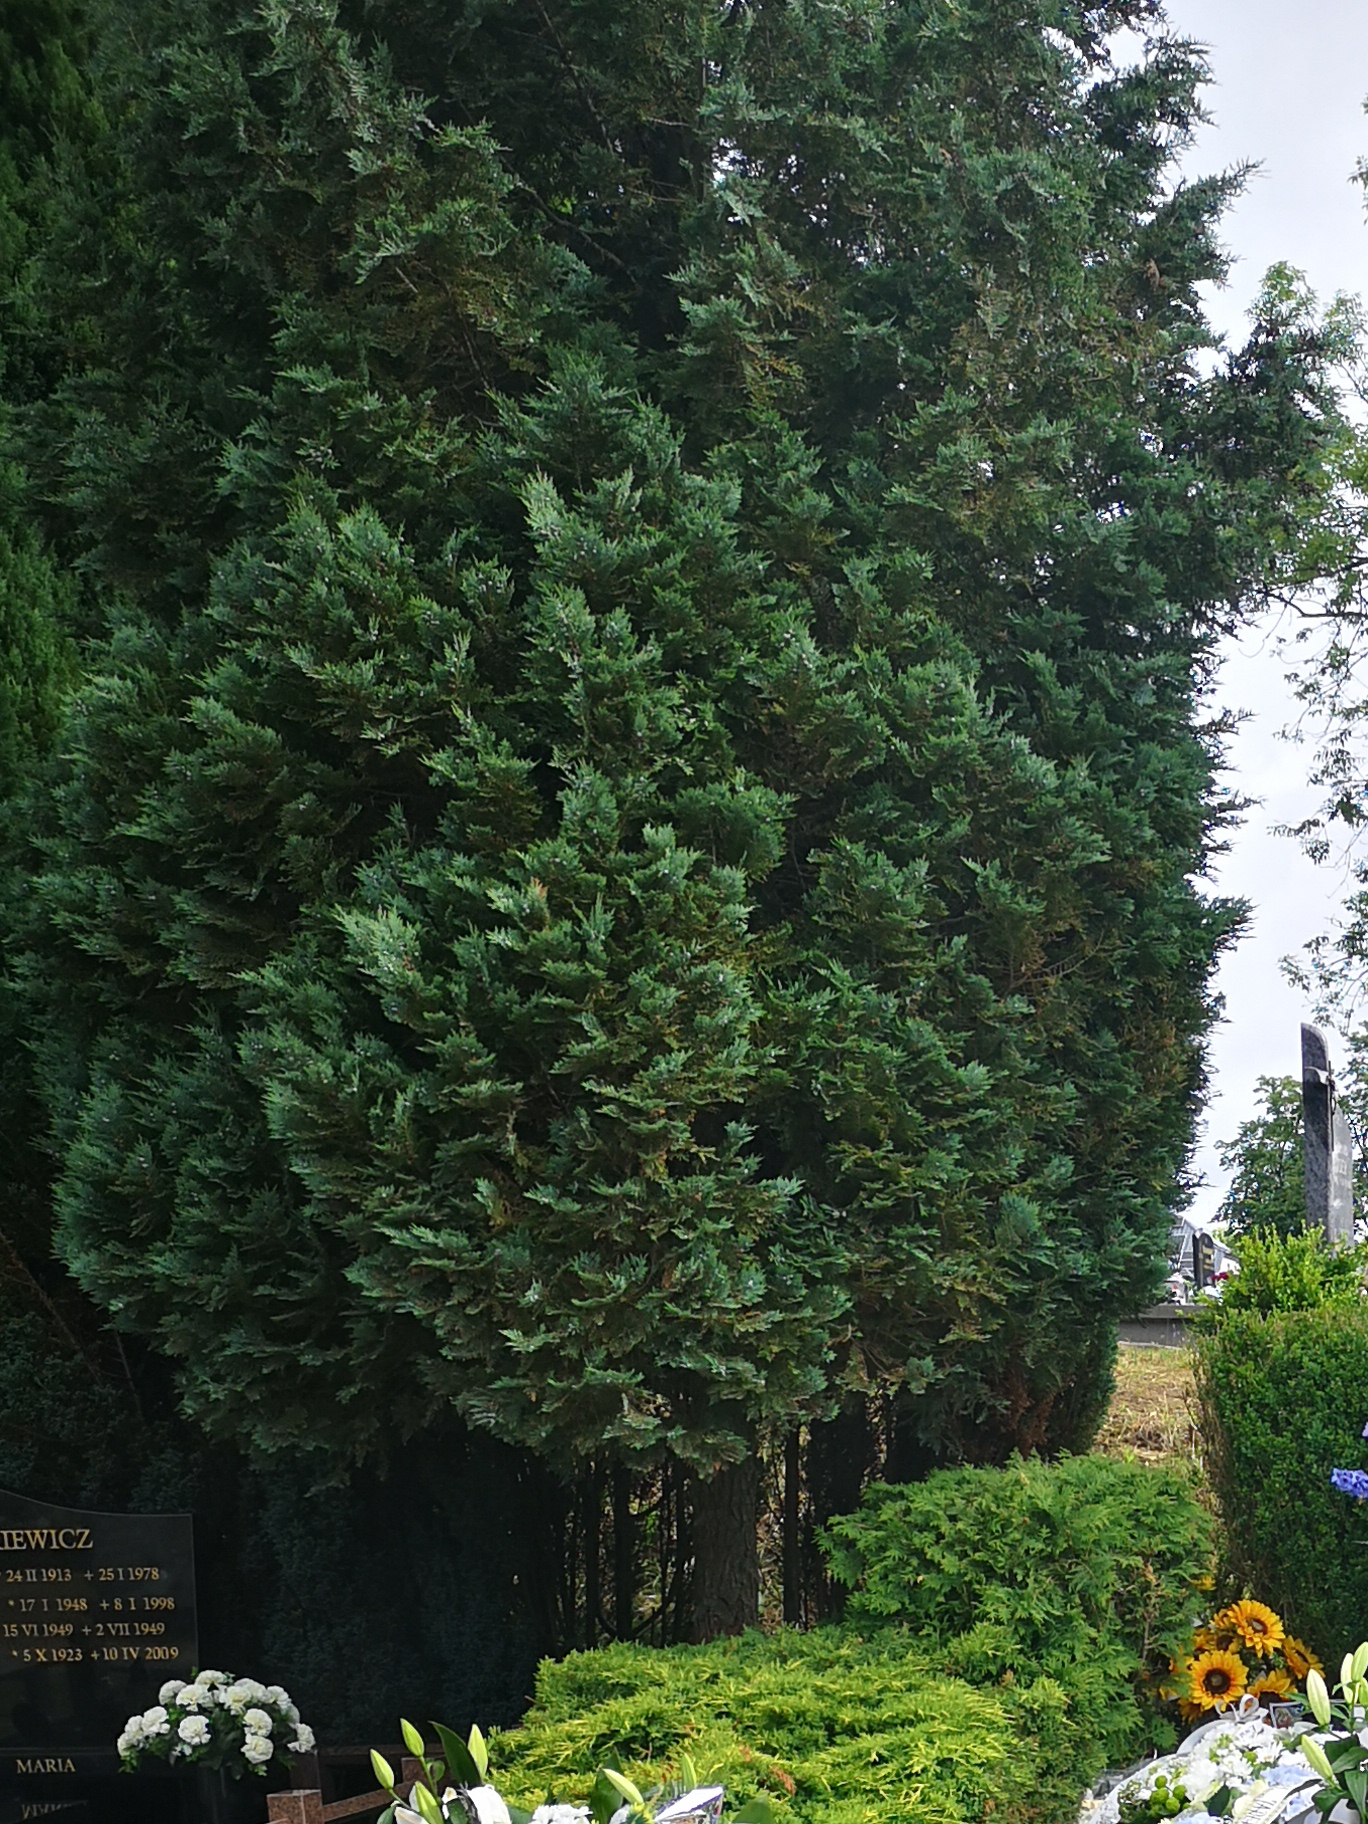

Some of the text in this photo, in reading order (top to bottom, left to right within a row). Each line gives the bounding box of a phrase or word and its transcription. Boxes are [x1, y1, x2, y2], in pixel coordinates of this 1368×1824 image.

[41, 1568, 72, 1582] 1913
[99, 1568, 115, 1581] 25
[128, 1567, 160, 1581] 1978
[20, 1599, 35, 1612] 17
[56, 1598, 88, 1611] 1948
[114, 1598, 123, 1611] 8
[143, 1597, 175, 1610] 1998
[42, 1623, 74, 1636] 1949
[96, 1624, 105, 1636] 2
[106, 1623, 130, 1636] VII
[134, 1622, 166, 1635] 1949
[23, 1649, 32, 1662] 5
[34, 1649, 48, 1662] X
[51, 1649, 83, 1662] 1923
[121, 1647, 140, 1660] IV
[144, 1647, 179, 1660] 2009
[16, 1758, 76, 1774] MARIA
